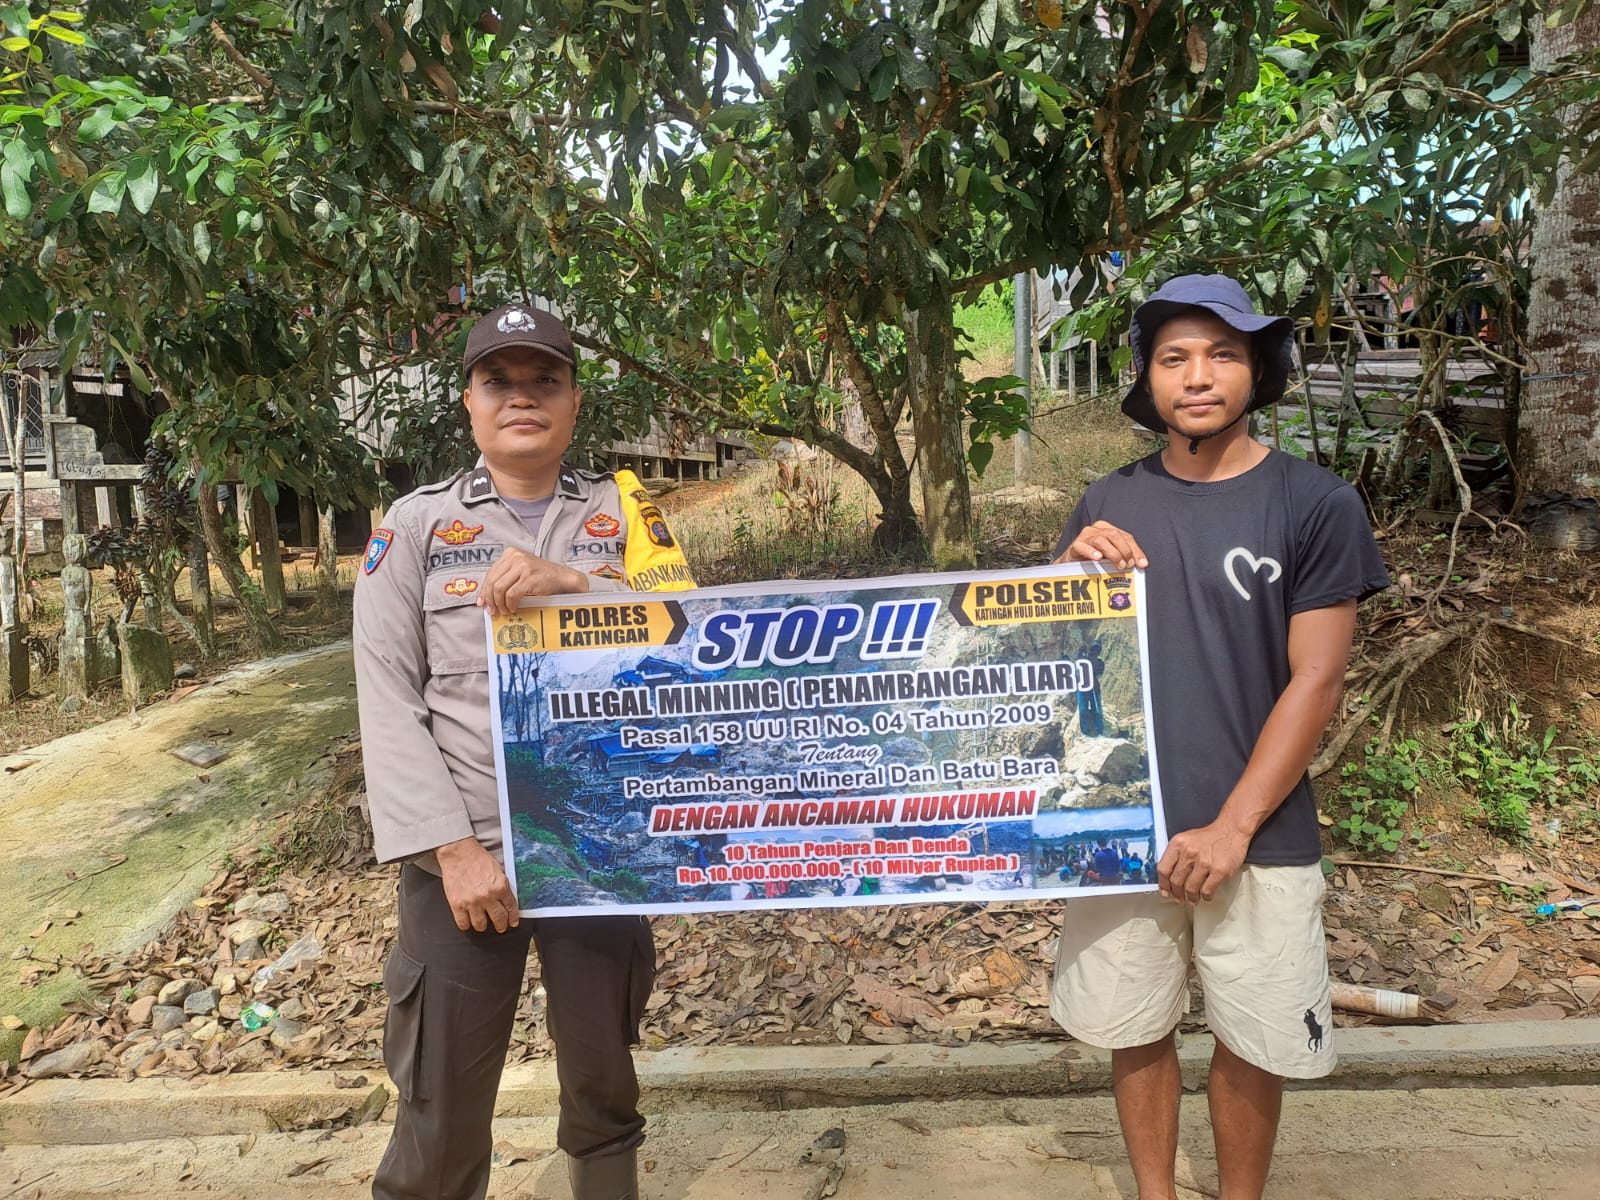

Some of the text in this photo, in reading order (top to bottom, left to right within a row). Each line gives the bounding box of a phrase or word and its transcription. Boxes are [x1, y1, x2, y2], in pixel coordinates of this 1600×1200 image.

[430, 548, 494, 568] DENNY
[573, 541, 626, 556] POLR
[975, 578, 1093, 607] POLSEK
[559, 604, 648, 629] POLRES
[975, 601, 1095, 622] KATINGAN HULU DAN BUKIT RAYA
[560, 628, 649, 647] KATINGAN
[697, 607, 860, 665] STOP
[551, 689, 652, 720] ILLEGAL
[658, 681, 782, 715] MINNING
[804, 667, 1008, 706] PENAMBANGAN
[1013, 663, 1074, 693] LIAR
[623, 704, 1051, 746] Pasal 158 UU RI No. 04 Tahun 2009
[800, 743, 880, 765] Tentang
[626, 758, 1056, 797] Pertambangan Mineral Dan Batu Bara
[652, 790, 1037, 833] DENGAN ANCAMAN HUKUMAN
[726, 838, 968, 861] 10 Tahun Penjara Dan Denda
[678, 868, 706, 885] Rp.
[887, 858, 942, 875] Milyar
[945, 856, 1007, 873] Rupiah
